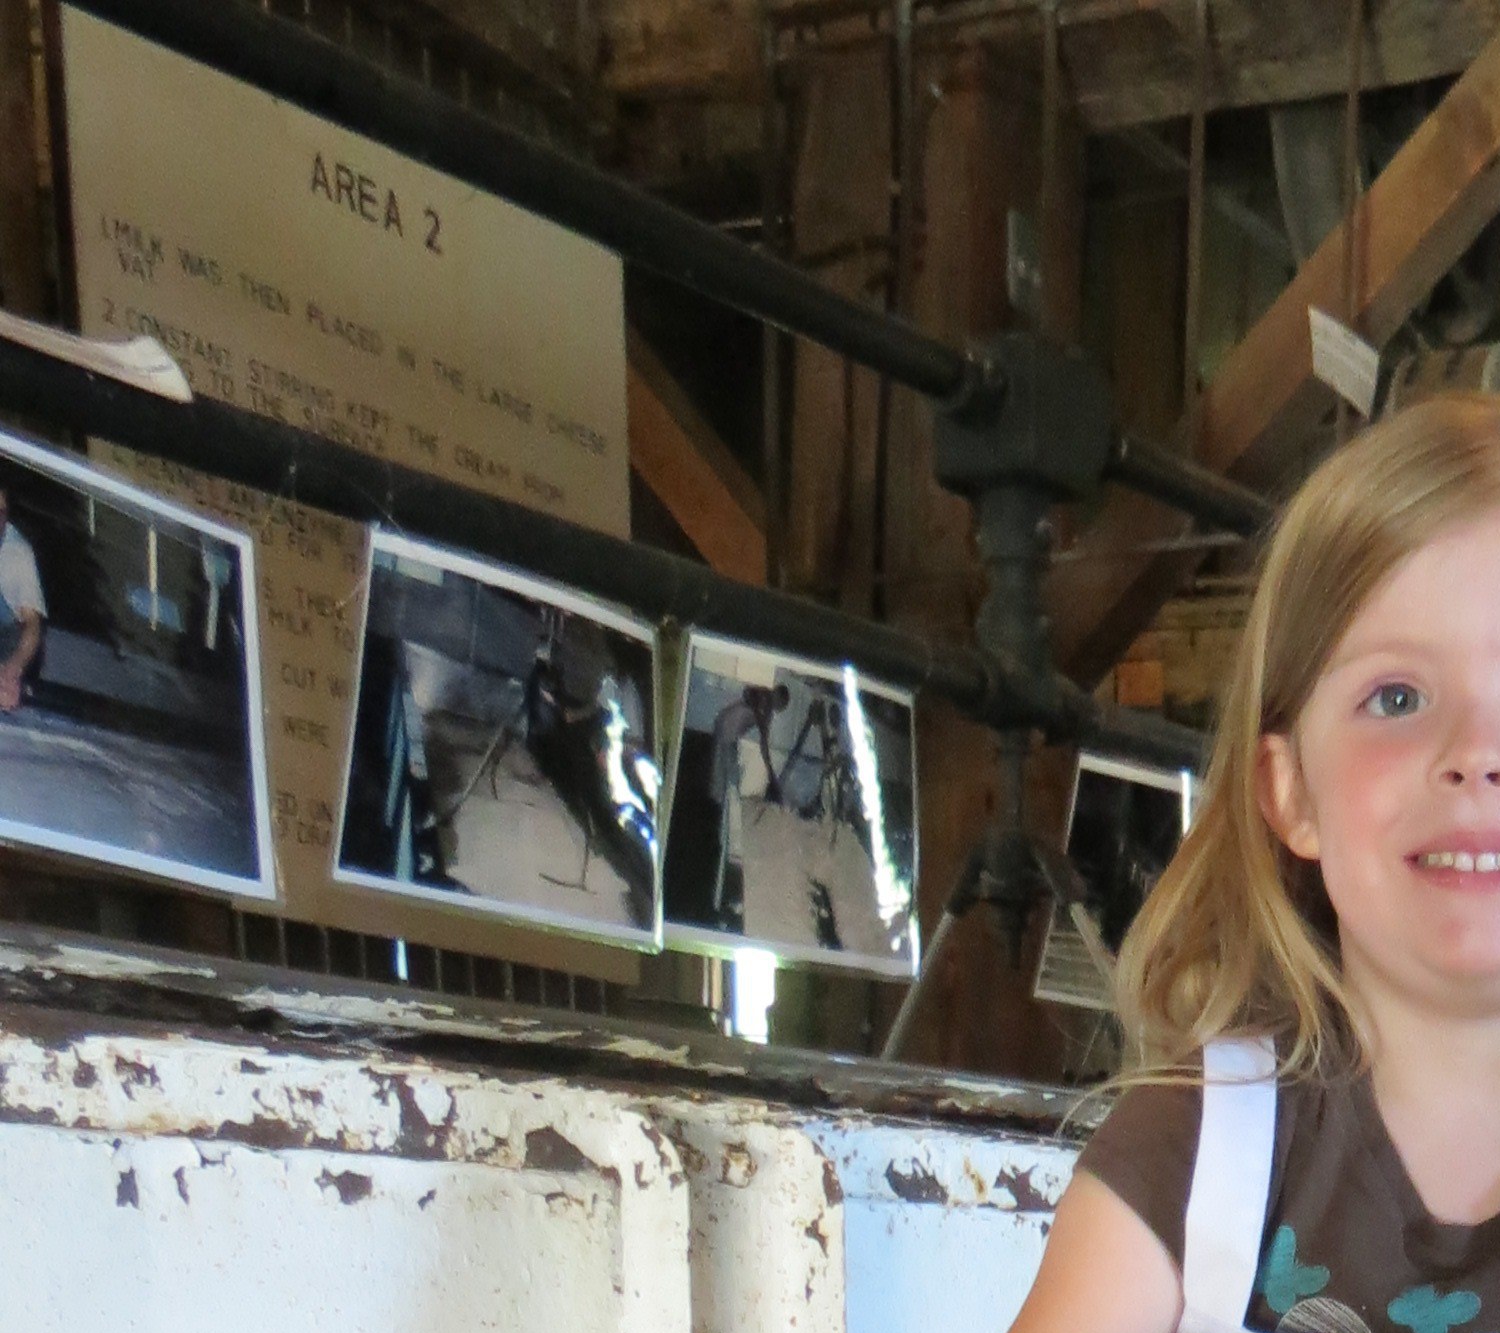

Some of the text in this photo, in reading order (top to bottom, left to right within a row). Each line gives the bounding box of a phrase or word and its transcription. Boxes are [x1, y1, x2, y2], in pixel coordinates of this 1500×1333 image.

[116, 247, 154, 285] VAT
[311, 152, 443, 256] AREA 2
[125, 305, 231, 367] CONSTANT
[248, 357, 335, 416] STIRRING
[347, 400, 392, 435] KEPT
[406, 422, 439, 458] THE
[454, 442, 512, 480] CREAM
[177, 246, 223, 287] WAS
[240, 272, 291, 316] THEN
[306, 300, 381, 357] PLACED
[397, 345, 416, 371] IN
[433, 357, 463, 395] THE
[476, 382, 533, 425] LARGE
[547, 412, 607, 457] CHEESE
